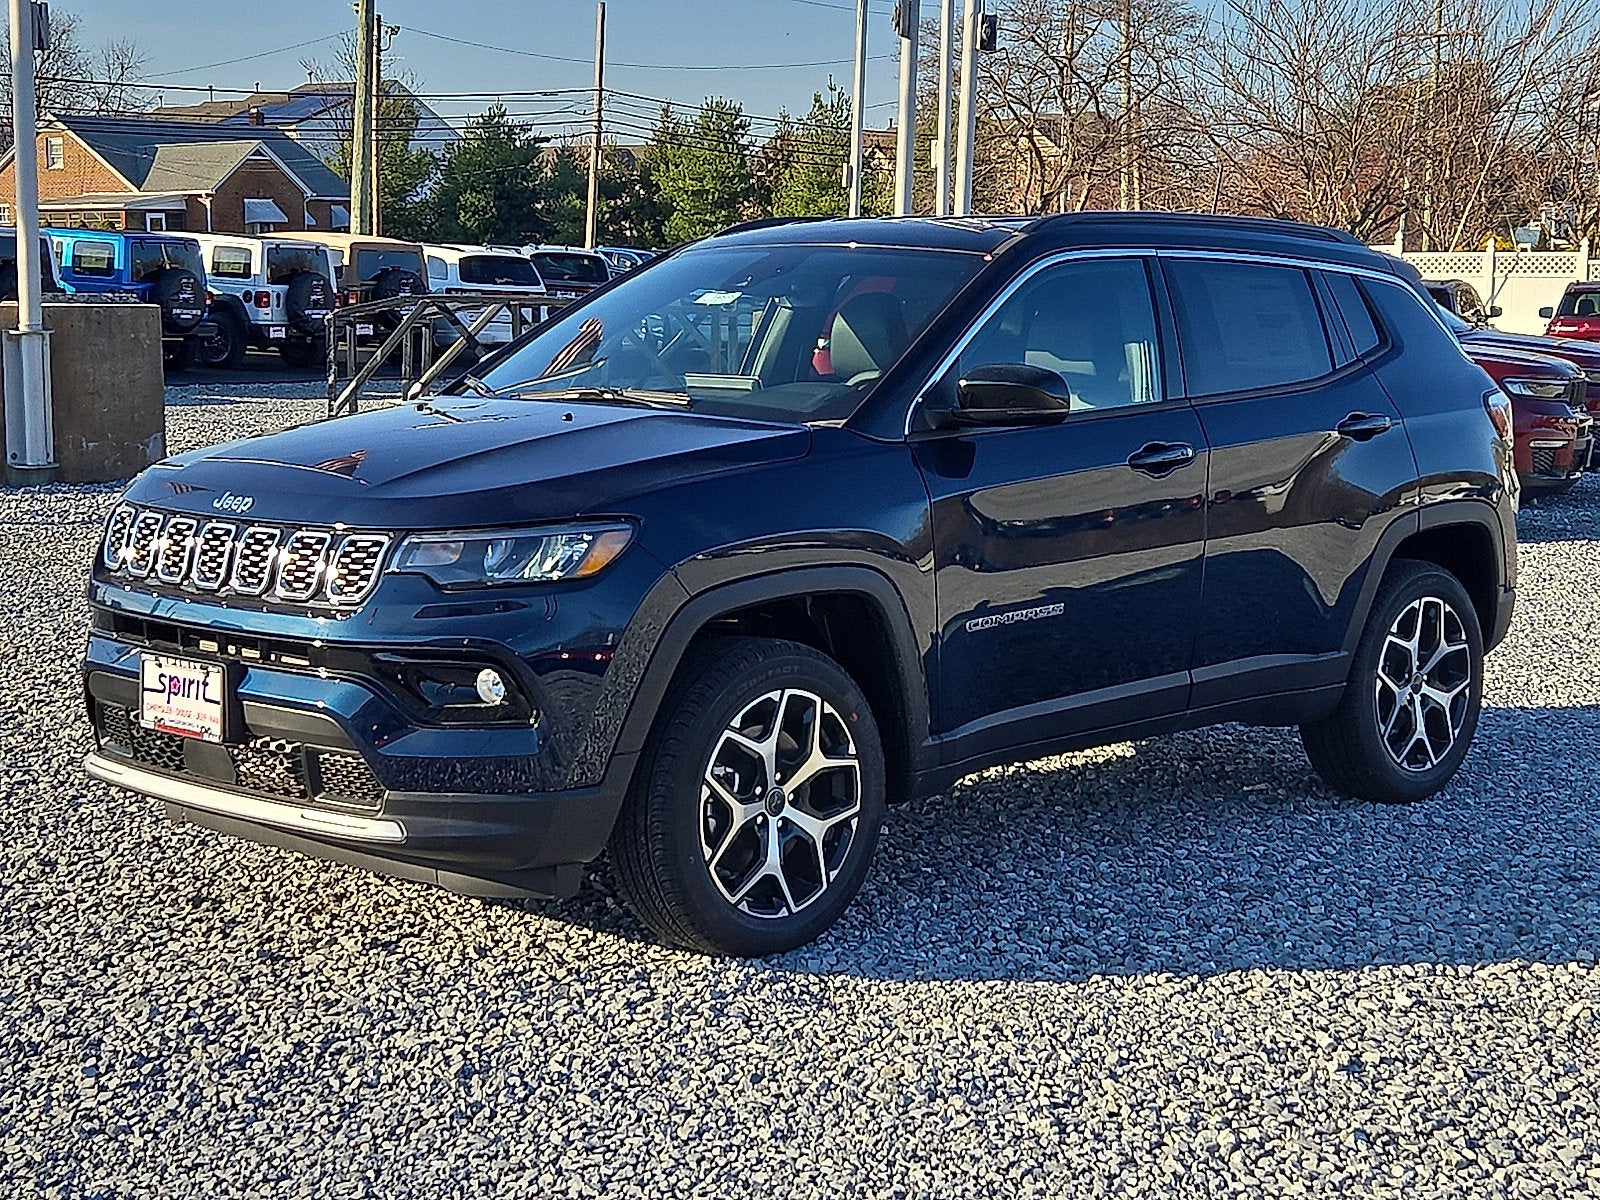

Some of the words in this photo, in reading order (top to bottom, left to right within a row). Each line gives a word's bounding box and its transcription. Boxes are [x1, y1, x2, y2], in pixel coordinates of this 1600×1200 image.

[212, 490, 253, 514] Jeep
[965, 602, 1065, 632] COMPASS
[144, 671, 221, 705] spirit
